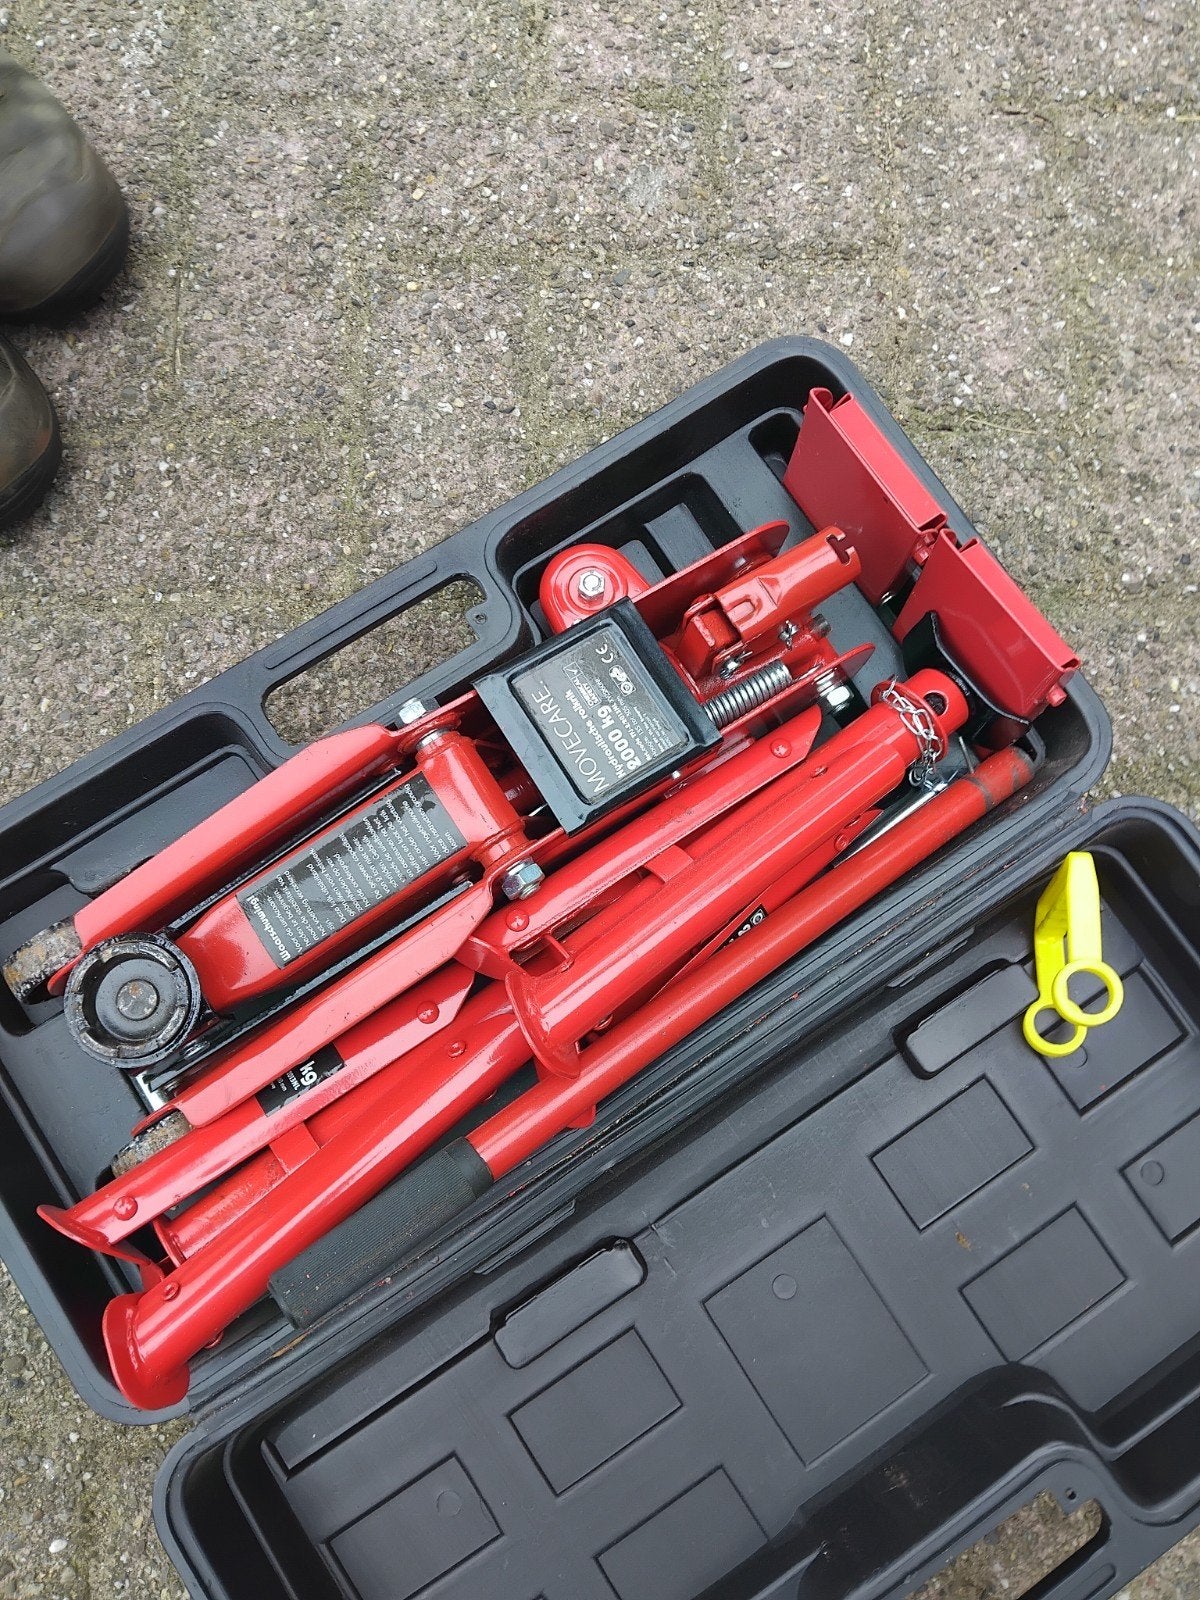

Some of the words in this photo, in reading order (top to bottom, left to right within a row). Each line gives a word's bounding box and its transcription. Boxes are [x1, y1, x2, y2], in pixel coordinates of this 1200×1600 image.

[563, 688, 588, 720] rolkrik
[591, 703, 618, 729] kg
[583, 718, 628, 779] Hydraulische
[606, 727, 642, 771] 2000
[372, 816, 383, 829] het
[275, 873, 285, 886] van
[332, 866, 341, 877] op
[369, 864, 379, 875] ton
[379, 880, 390, 894] van
[244, 893, 294, 961] Waarschuwing!
[294, 925, 311, 947] heden
[316, 923, 327, 936] het
[295, 1059, 322, 1087] kg
